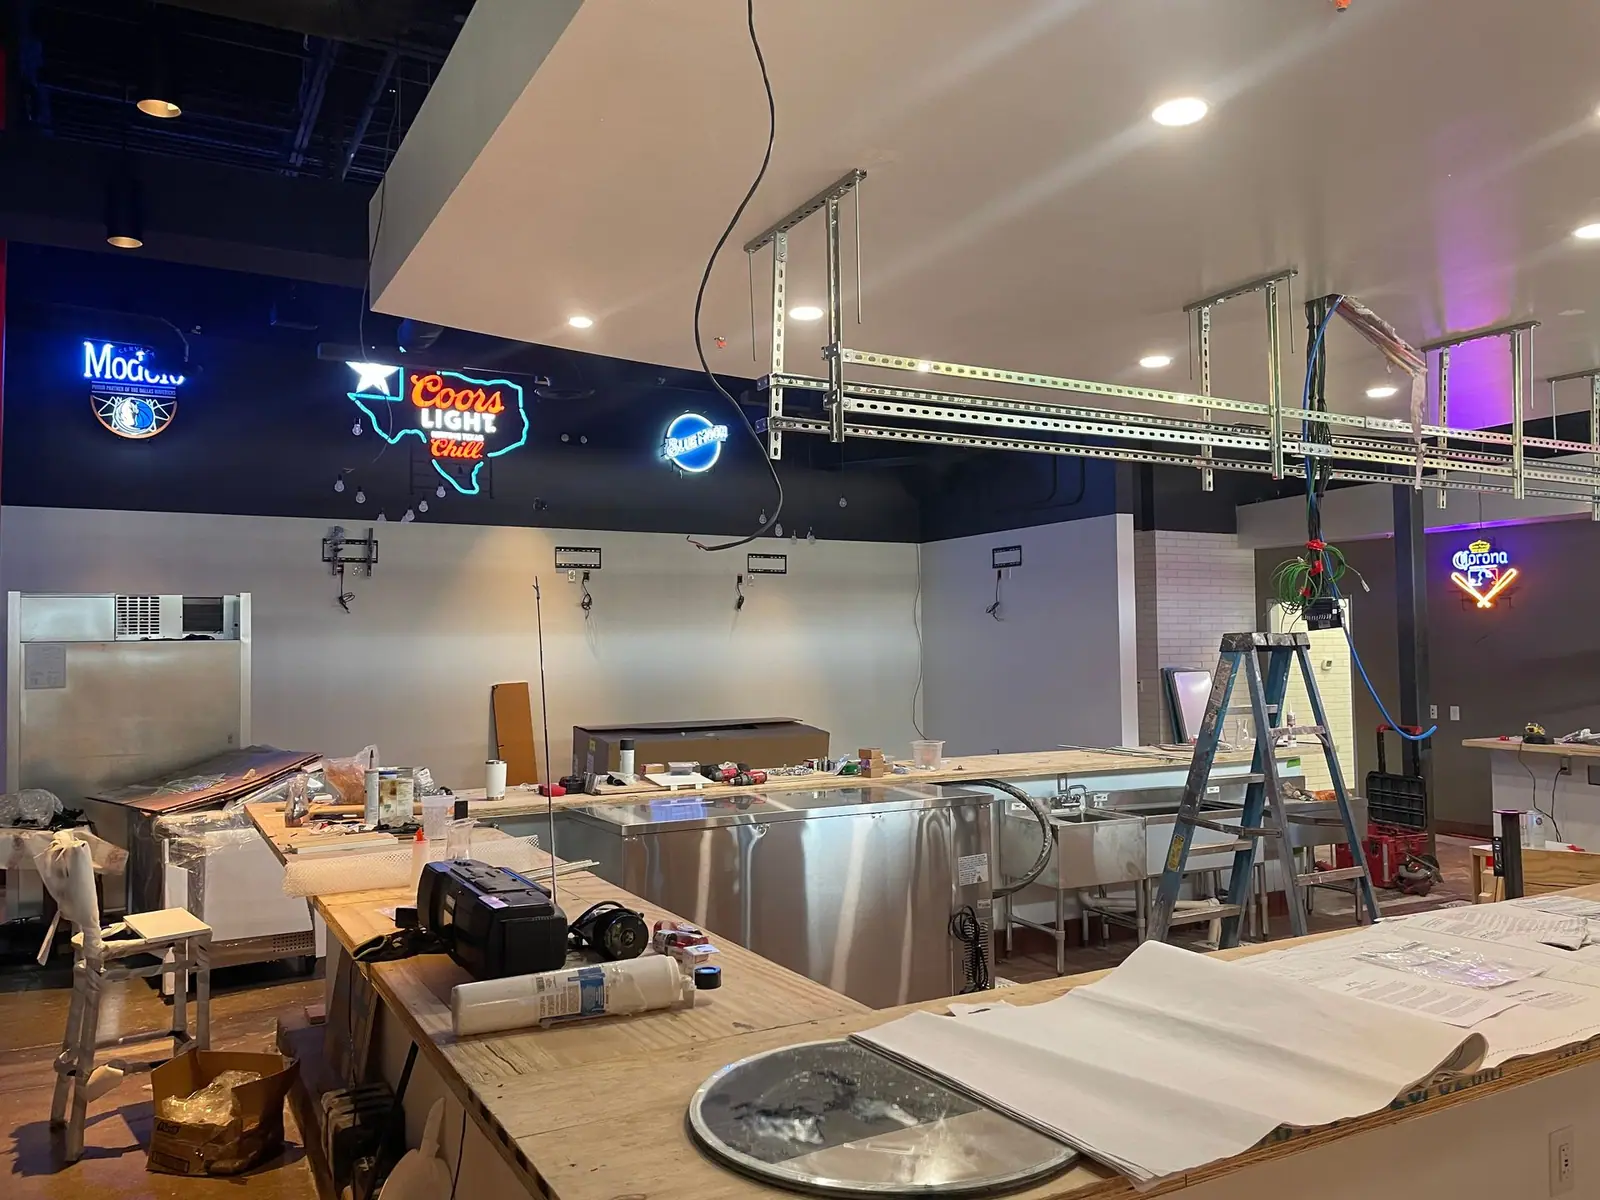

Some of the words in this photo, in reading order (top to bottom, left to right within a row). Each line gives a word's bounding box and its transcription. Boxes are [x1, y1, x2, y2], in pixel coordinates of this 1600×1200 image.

[410, 374, 505, 413] Coors
[421, 408, 496, 433] LIGHT
[431, 439, 484, 458] Chill
[1453, 551, 1508, 570] Corona
